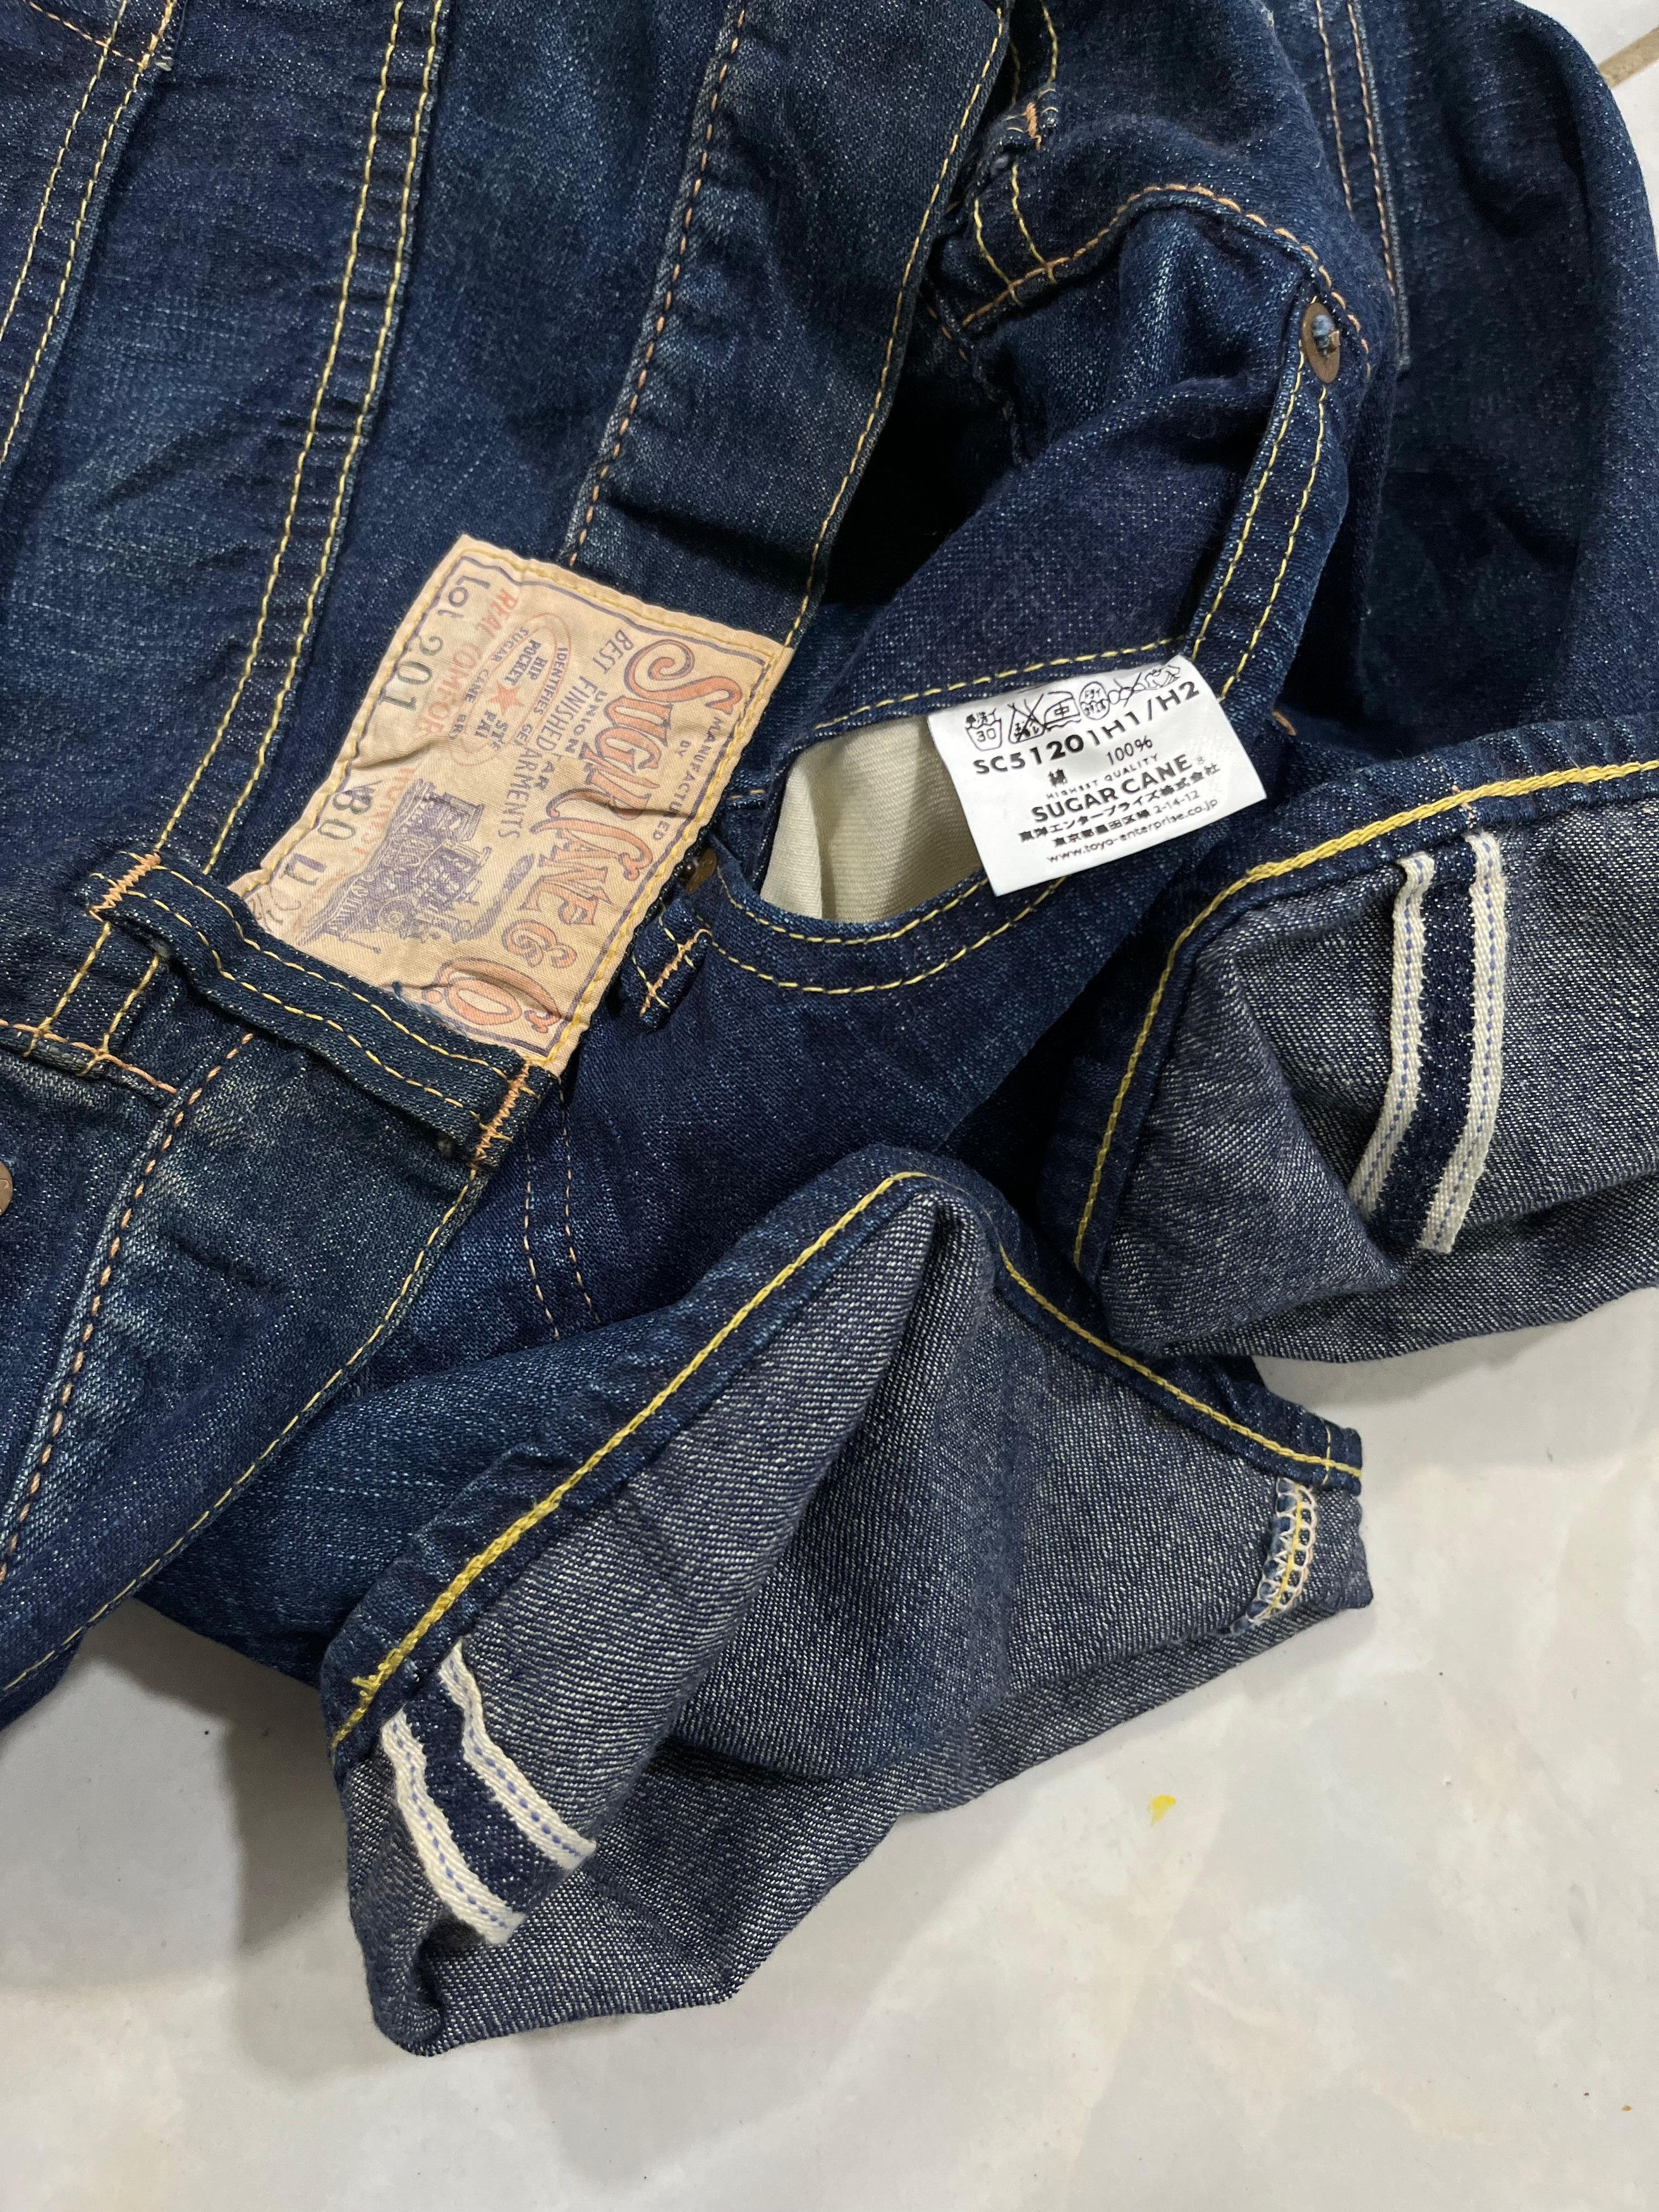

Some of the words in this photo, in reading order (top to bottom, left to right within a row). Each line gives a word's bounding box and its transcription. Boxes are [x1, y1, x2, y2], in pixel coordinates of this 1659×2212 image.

[438, 575, 490, 619] Lot
[477, 588, 518, 639] REAL
[381, 636, 443, 712] 201
[505, 638, 542, 686] POCKET
[527, 656, 548, 681] HIP
[593, 629, 634, 674] BEST
[533, 647, 568, 716] IDENTIFIES
[535, 676, 599, 752] FINISHED
[564, 687, 608, 755] UNION
[973, 681, 1199, 774] SC51201H1/H2
[976, 727, 997, 742] 30
[677, 739, 691, 756] BY
[1107, 735, 1153, 766] 100%
[497, 748, 542, 839] ARMENTS
[653, 717, 723, 840] MANUFACTUED
[1031, 787, 1119, 822] SUGAR
[1121, 754, 1193, 794] CANE
[1046, 780, 1098, 799] HIGHEST
[1104, 753, 1157, 782] QUALITY
[1153, 790, 1200, 814] 2-14-12
[1047, 799, 1218, 863] www.toyo-enterprise.co.jp
[502, 920, 578, 969] &
